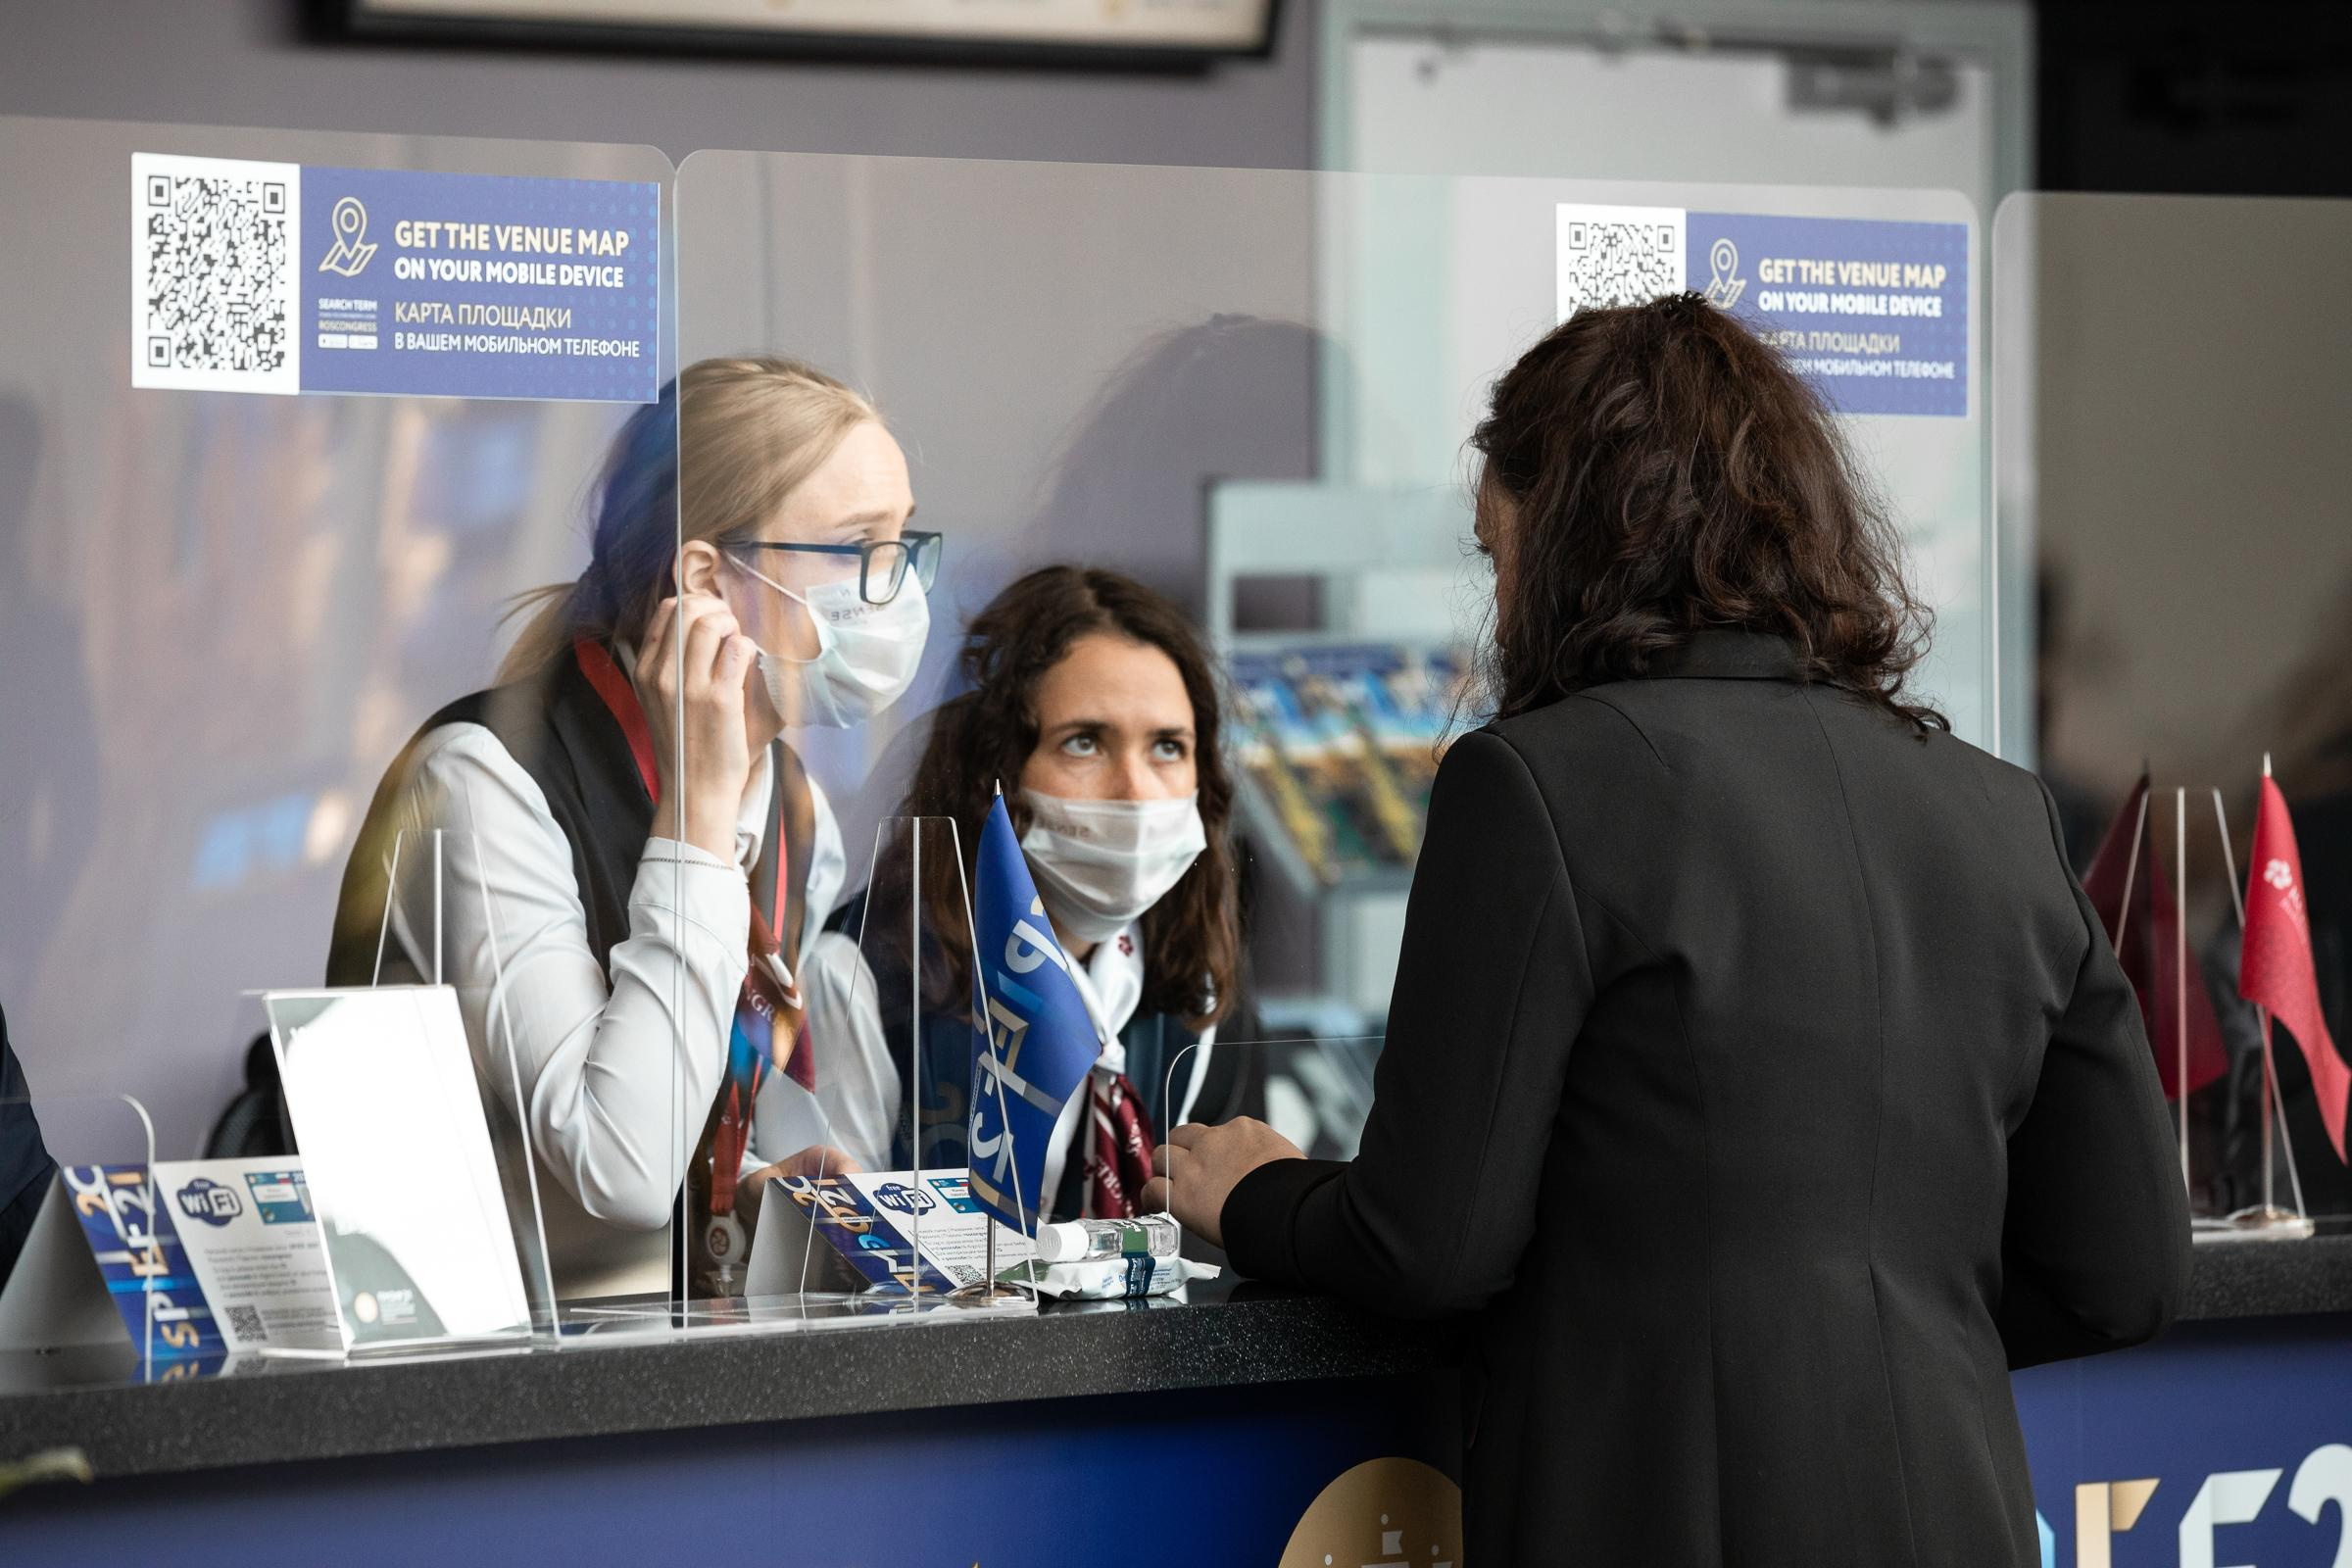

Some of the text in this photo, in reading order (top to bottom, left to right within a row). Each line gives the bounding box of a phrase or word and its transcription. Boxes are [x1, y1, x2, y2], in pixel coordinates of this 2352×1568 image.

[394, 220, 630, 256] GET THE VENUE MAP
[394, 257, 624, 288] ON YOUR MOBILE DEVICE
[1758, 258, 1946, 290] GET THE VENUE MAP
[354, 299, 377, 312] TERM
[395, 301, 571, 331] КАРТА ПЛОЩАДКИ
[1758, 290, 1942, 318] ON YOUR MOBILE DEVICE
[394, 332, 405, 350] В
[407, 332, 462, 352] ВАШЕМ
[465, 334, 562, 356] МОБИЛЬНОМ
[564, 338, 640, 359] ТЕЛЕФОНЕ
[1809, 330, 1901, 356] ПЛОЩАДКИ
[1814, 358, 1892, 377] МОБИЛЬНОМ
[1893, 360, 1955, 379] ТЕЛЕФОНЕ
